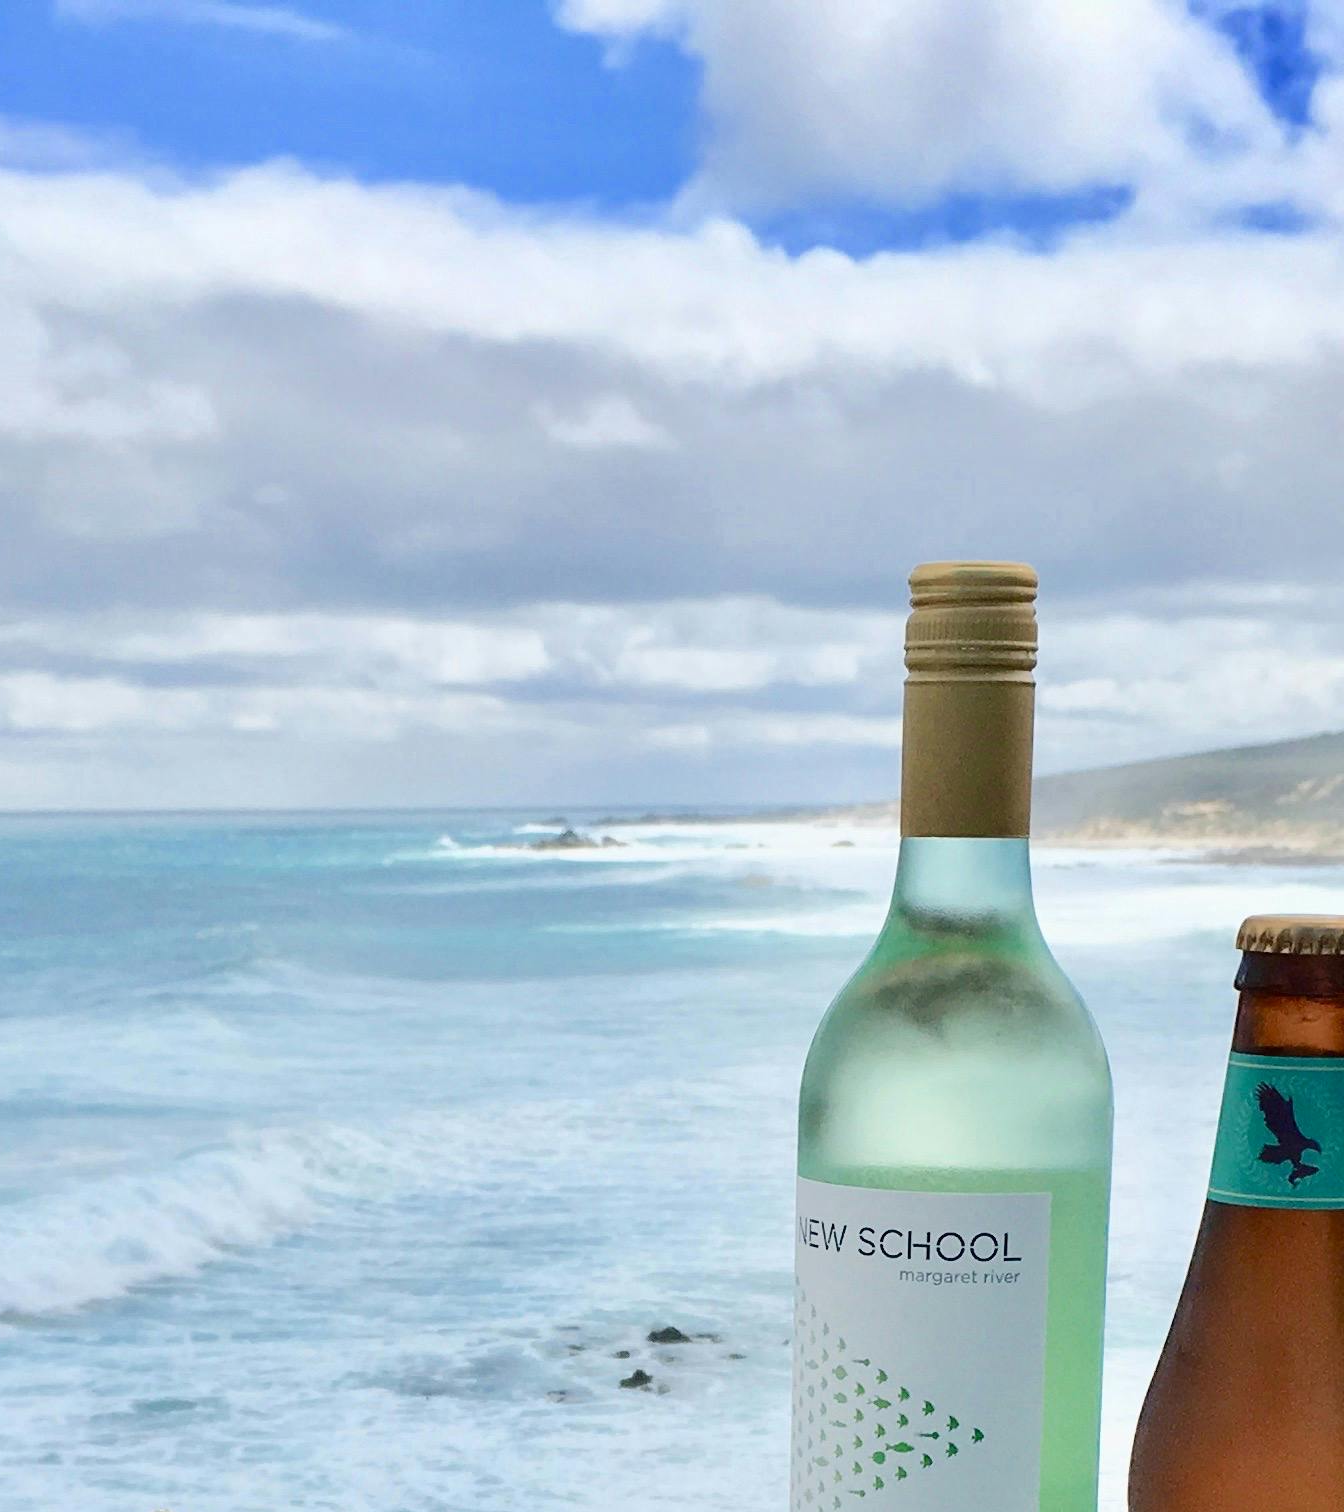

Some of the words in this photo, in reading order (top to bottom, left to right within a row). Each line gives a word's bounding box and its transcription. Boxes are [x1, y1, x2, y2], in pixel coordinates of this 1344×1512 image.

[799, 1216, 847, 1252] NEW
[858, 1227, 1022, 1261] SCHOOL
[899, 1268, 977, 1286] margaret
[983, 1271, 1020, 1285] river
